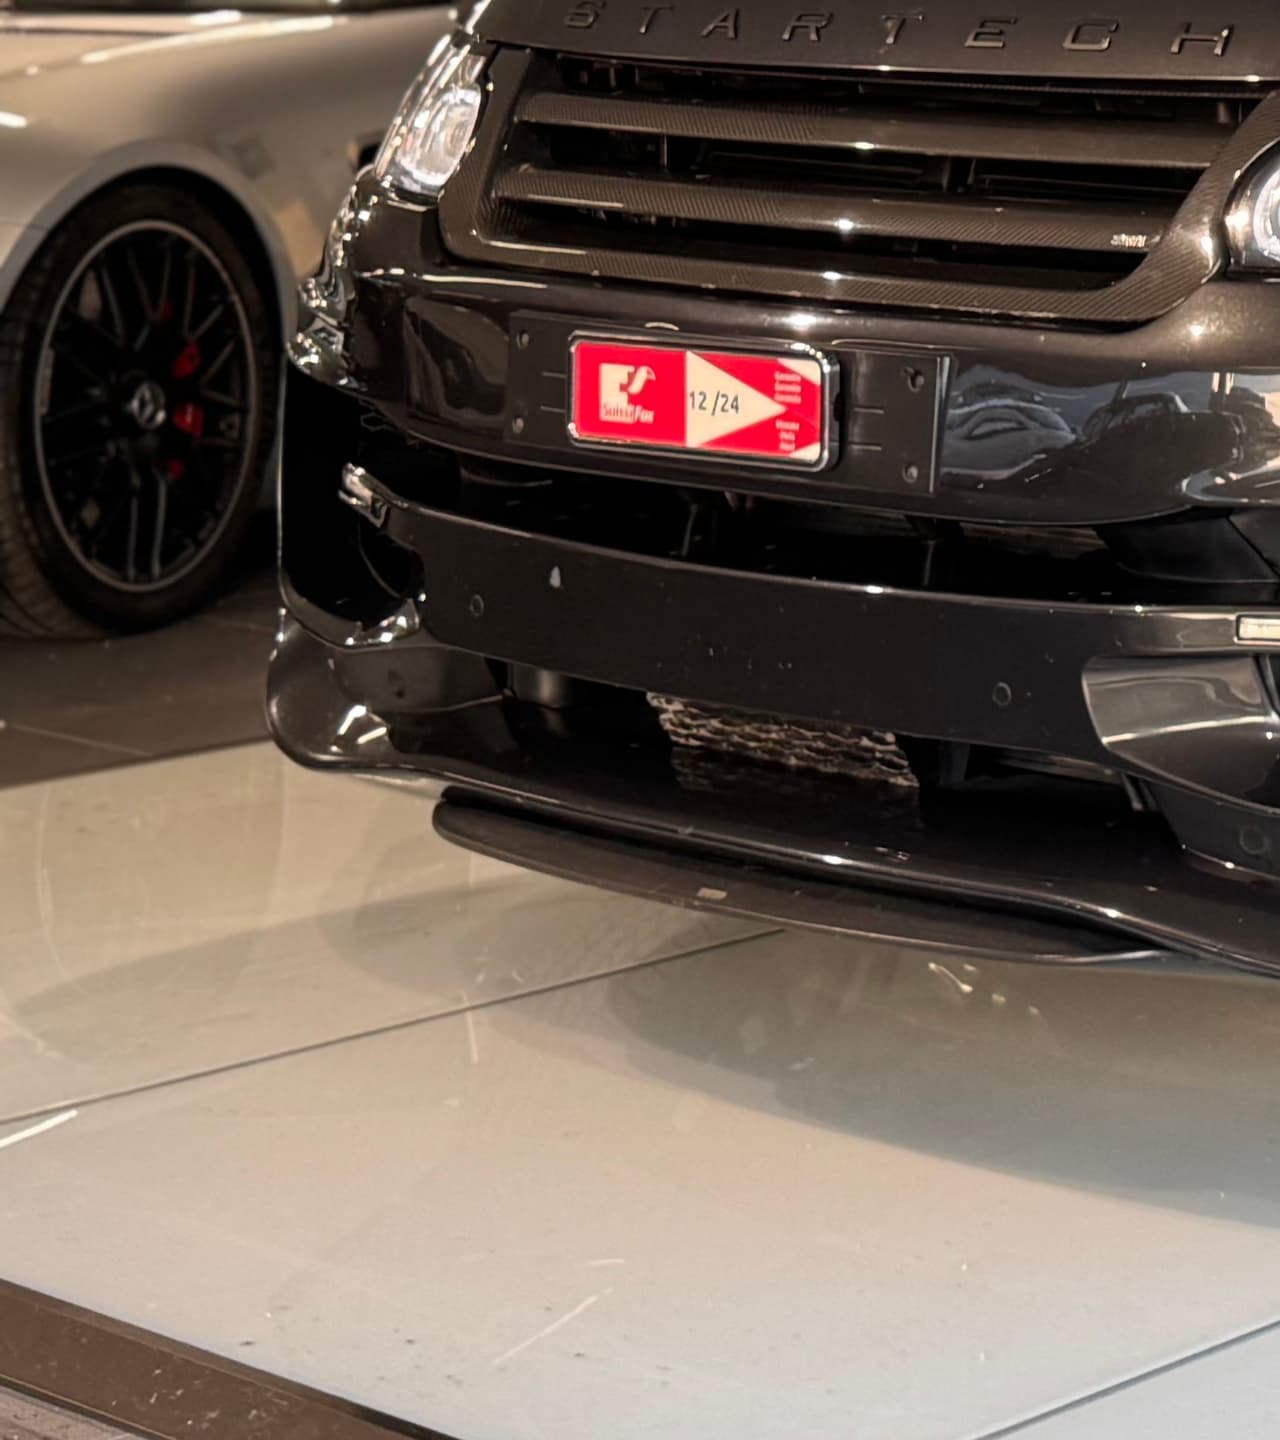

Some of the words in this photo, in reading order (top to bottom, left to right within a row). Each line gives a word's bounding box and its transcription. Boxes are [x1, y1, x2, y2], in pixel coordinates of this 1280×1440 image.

[564, 0, 1236, 57] STARTECH
[688, 391, 708, 412] 12
[710, 390, 740, 417] /24
